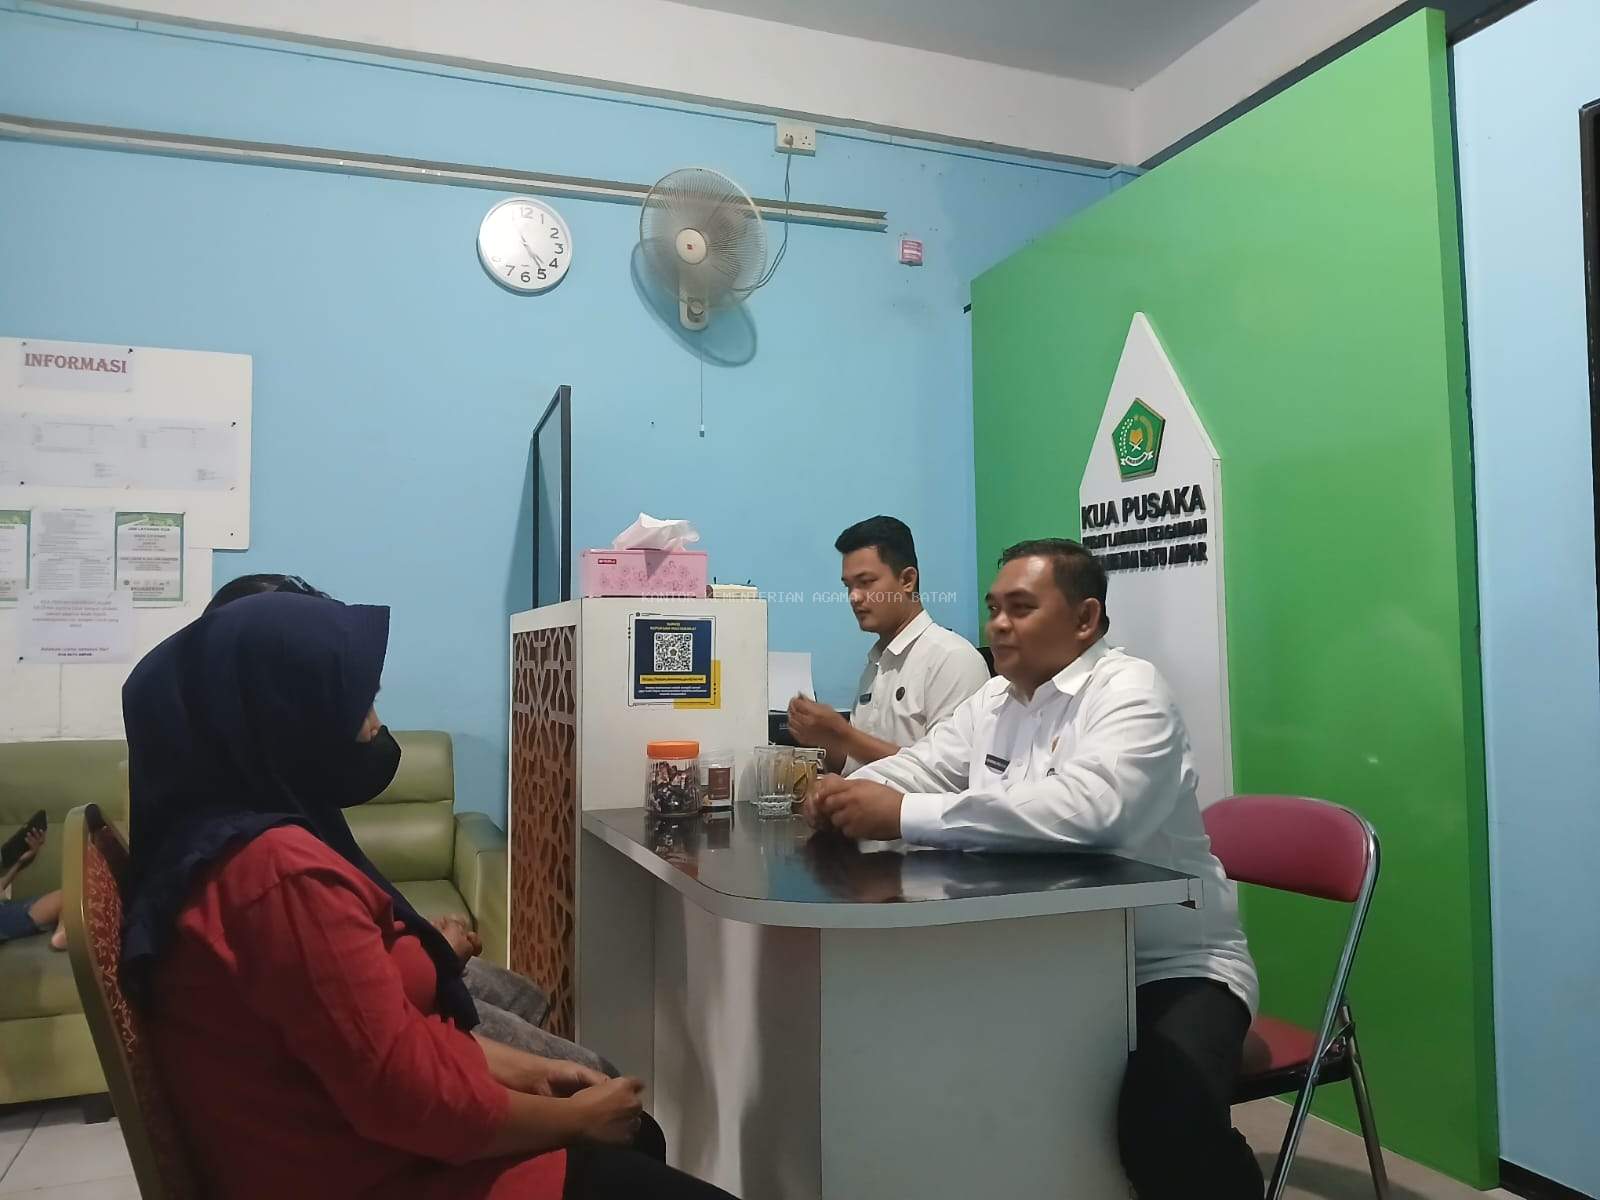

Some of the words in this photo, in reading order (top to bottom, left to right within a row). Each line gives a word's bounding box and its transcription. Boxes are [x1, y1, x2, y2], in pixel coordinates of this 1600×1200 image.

[520, 207, 534, 219] 12
[540, 213, 545, 225] 1
[550, 227, 559, 239] 2
[554, 243, 564, 254] 3
[548, 257, 559, 269] 4
[505, 264, 516, 277] 7
[537, 268, 547, 280] 5
[520, 271, 531, 283] 6
[24, 352, 127, 374] INFORMASI
[1081, 500, 1120, 530] KUA
[1122, 484, 1206, 523] PUSAKA
